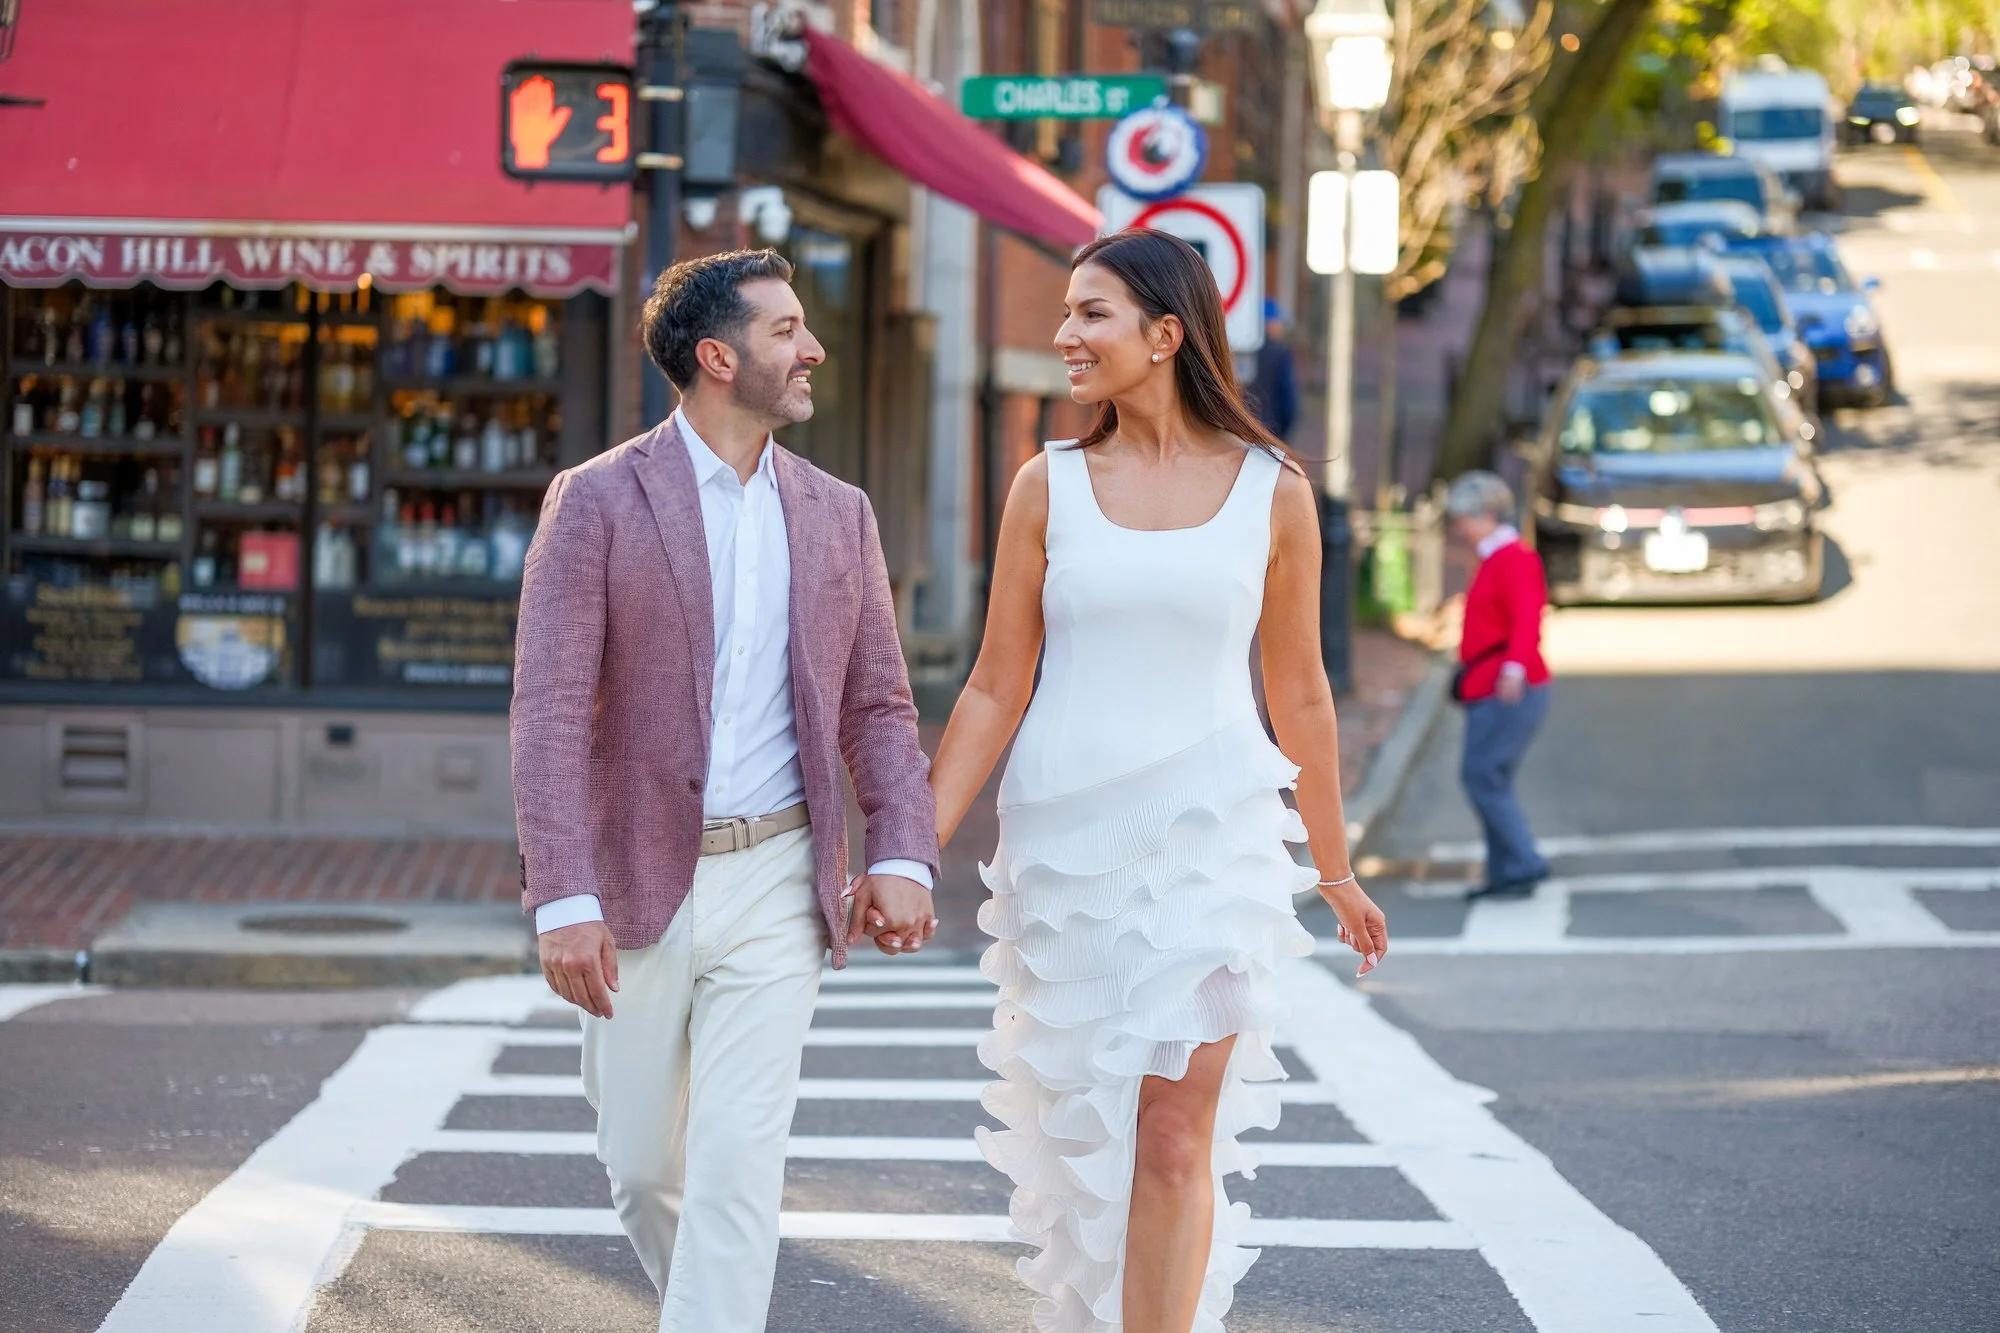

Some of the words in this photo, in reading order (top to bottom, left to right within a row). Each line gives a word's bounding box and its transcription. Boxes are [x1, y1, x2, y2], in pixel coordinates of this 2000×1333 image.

[993, 79, 1101, 114] CHARLES
[1104, 86, 1131, 113] ST
[597, 83, 629, 163] 3
[121, 237, 226, 274] HILL
[237, 238, 355, 276] WINE
[364, 241, 398, 277] &
[408, 241, 572, 283] SPIRITS
